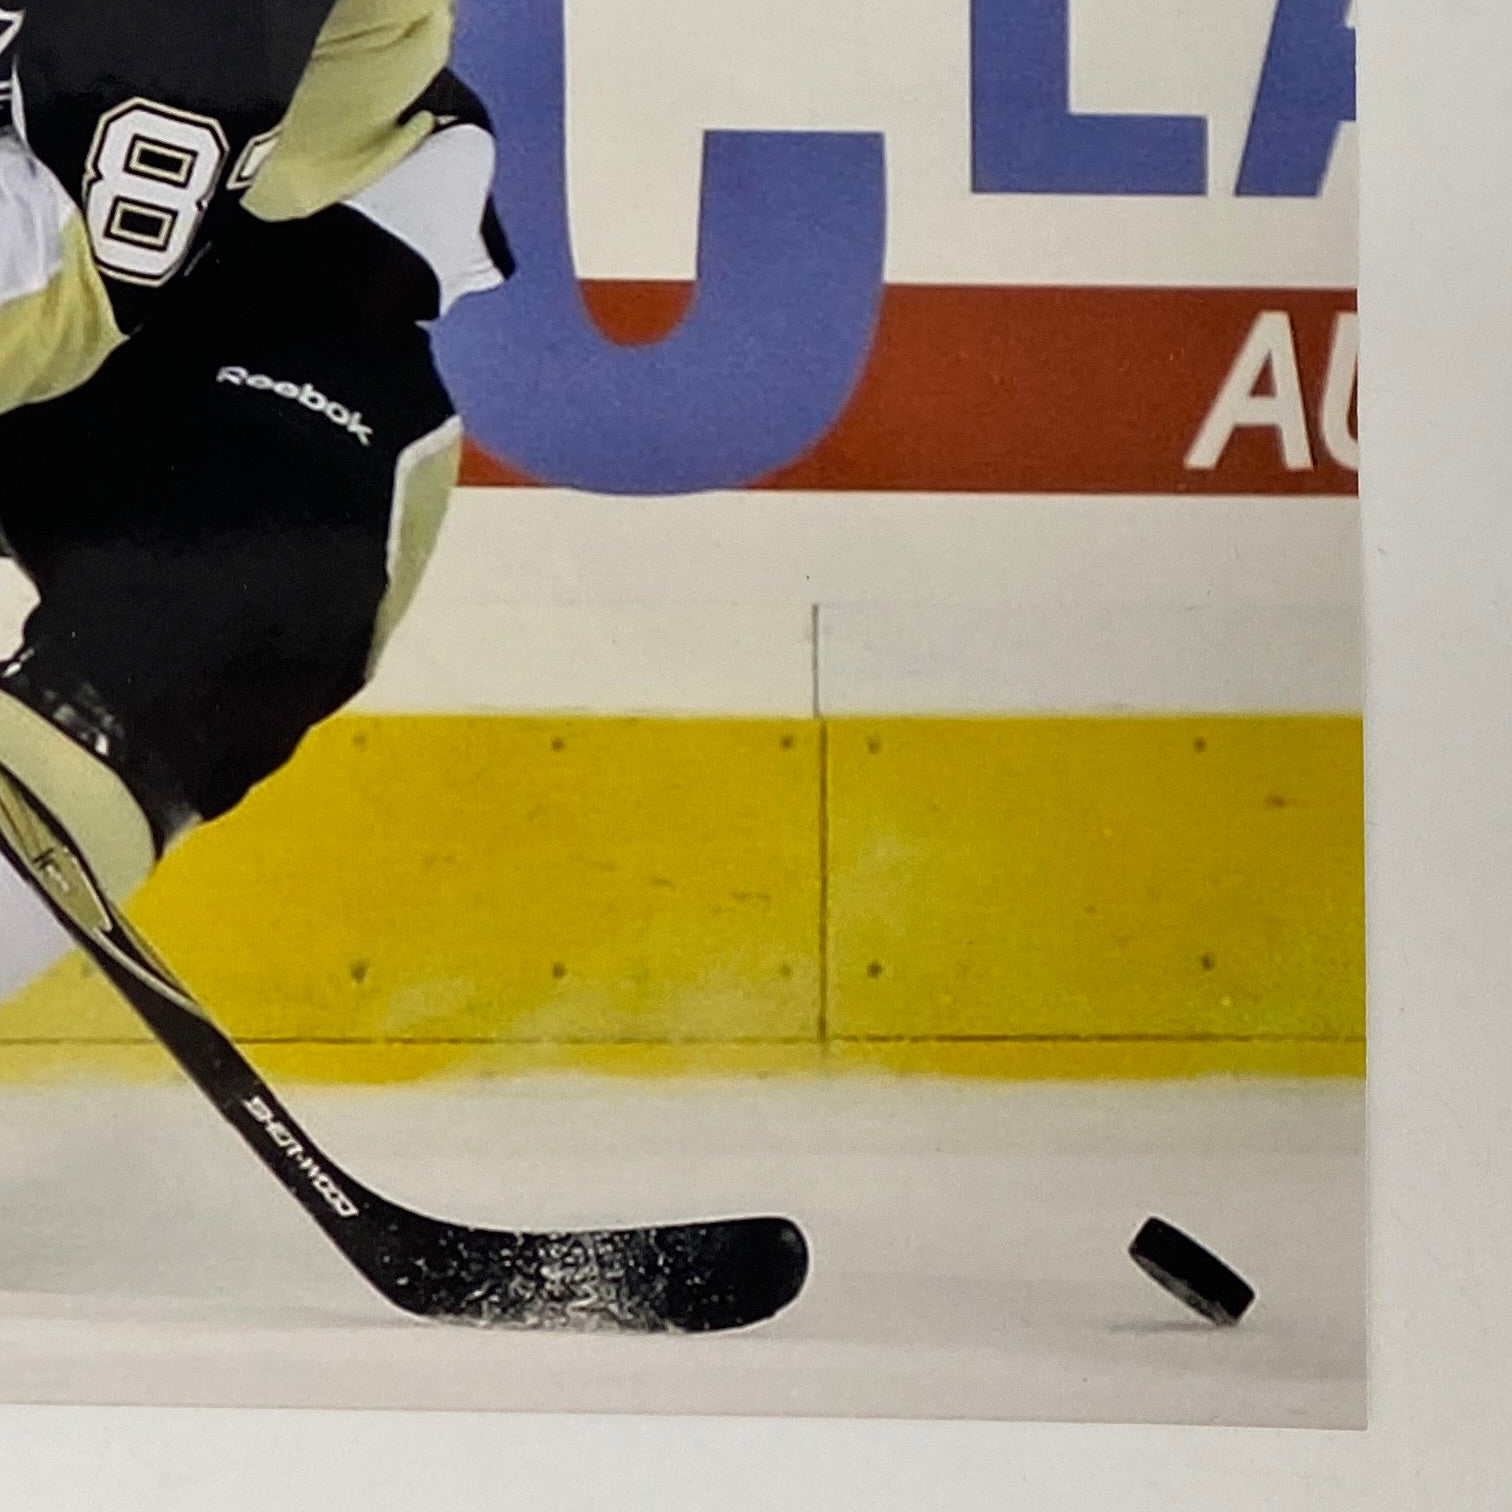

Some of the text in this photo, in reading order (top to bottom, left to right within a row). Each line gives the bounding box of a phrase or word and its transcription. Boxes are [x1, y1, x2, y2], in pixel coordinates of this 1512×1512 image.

[82, 96, 283, 288] 8
[216, 365, 373, 447] Reebok
[1183, 310, 1357, 471] A
